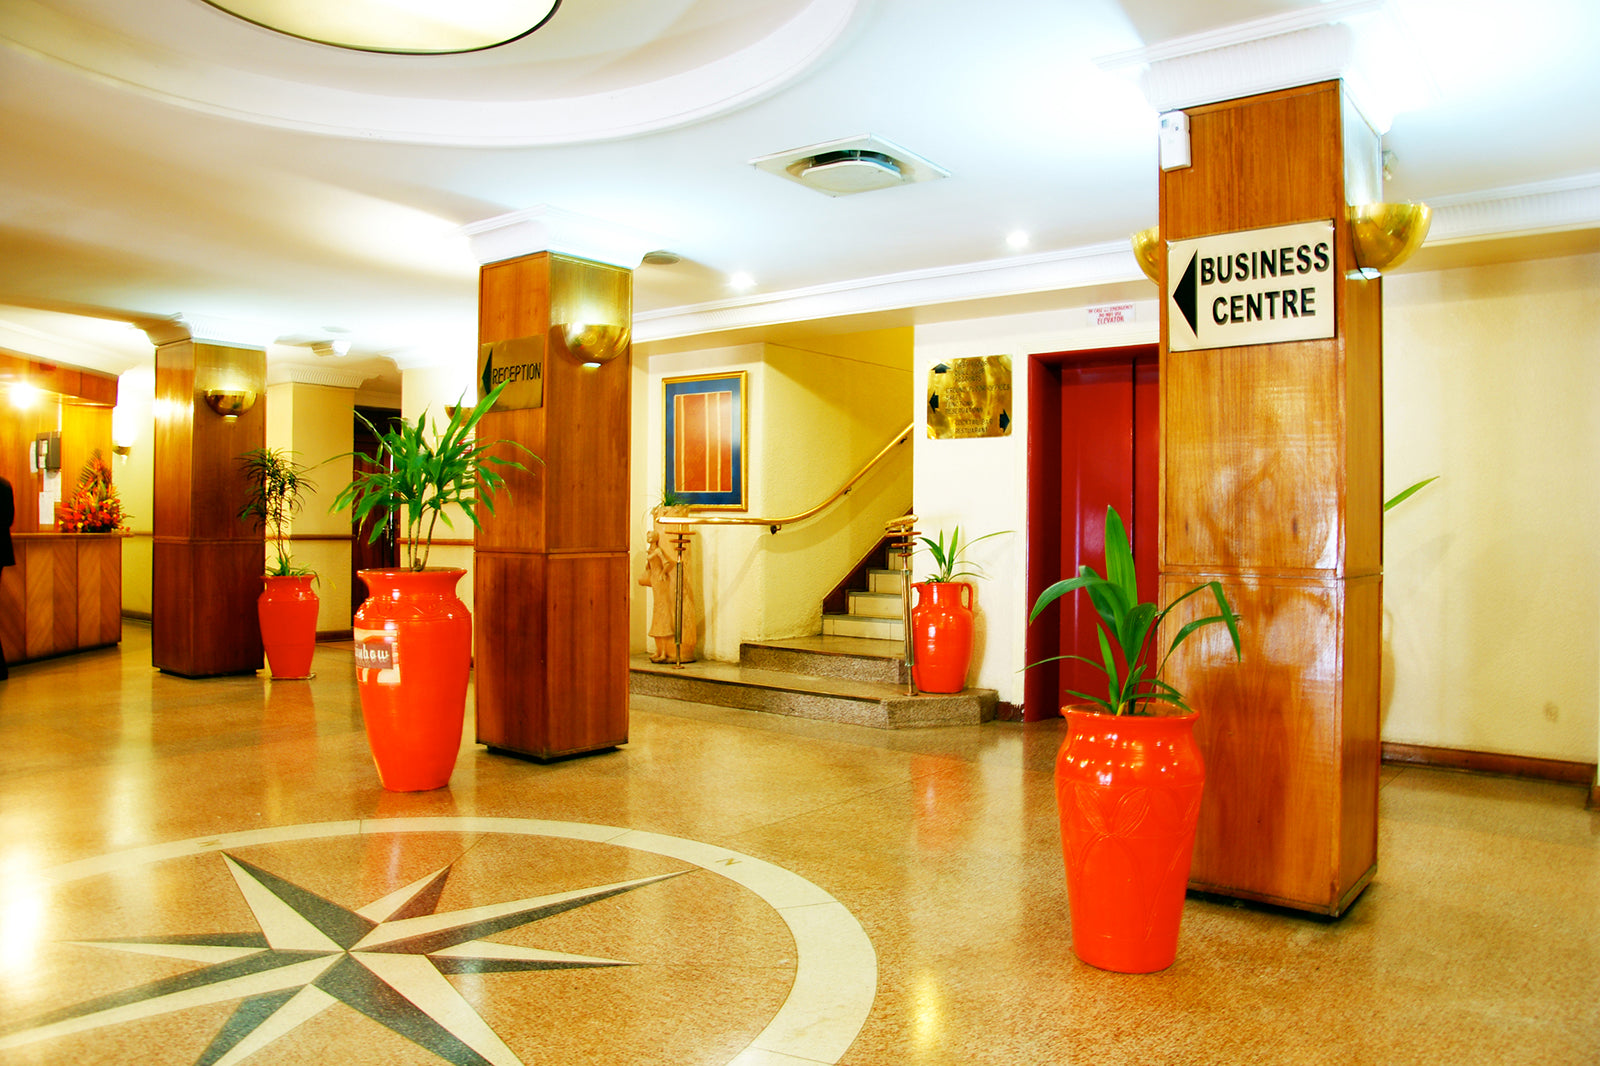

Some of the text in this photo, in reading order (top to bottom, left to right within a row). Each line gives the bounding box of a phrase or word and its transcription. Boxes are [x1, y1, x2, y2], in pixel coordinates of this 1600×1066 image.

[1201, 243, 1330, 286] BUSINESS
[1097, 316, 1124, 325] ELEVATOR
[1213, 287, 1315, 326] CENTRE
[492, 362, 541, 384] RECEPTION
